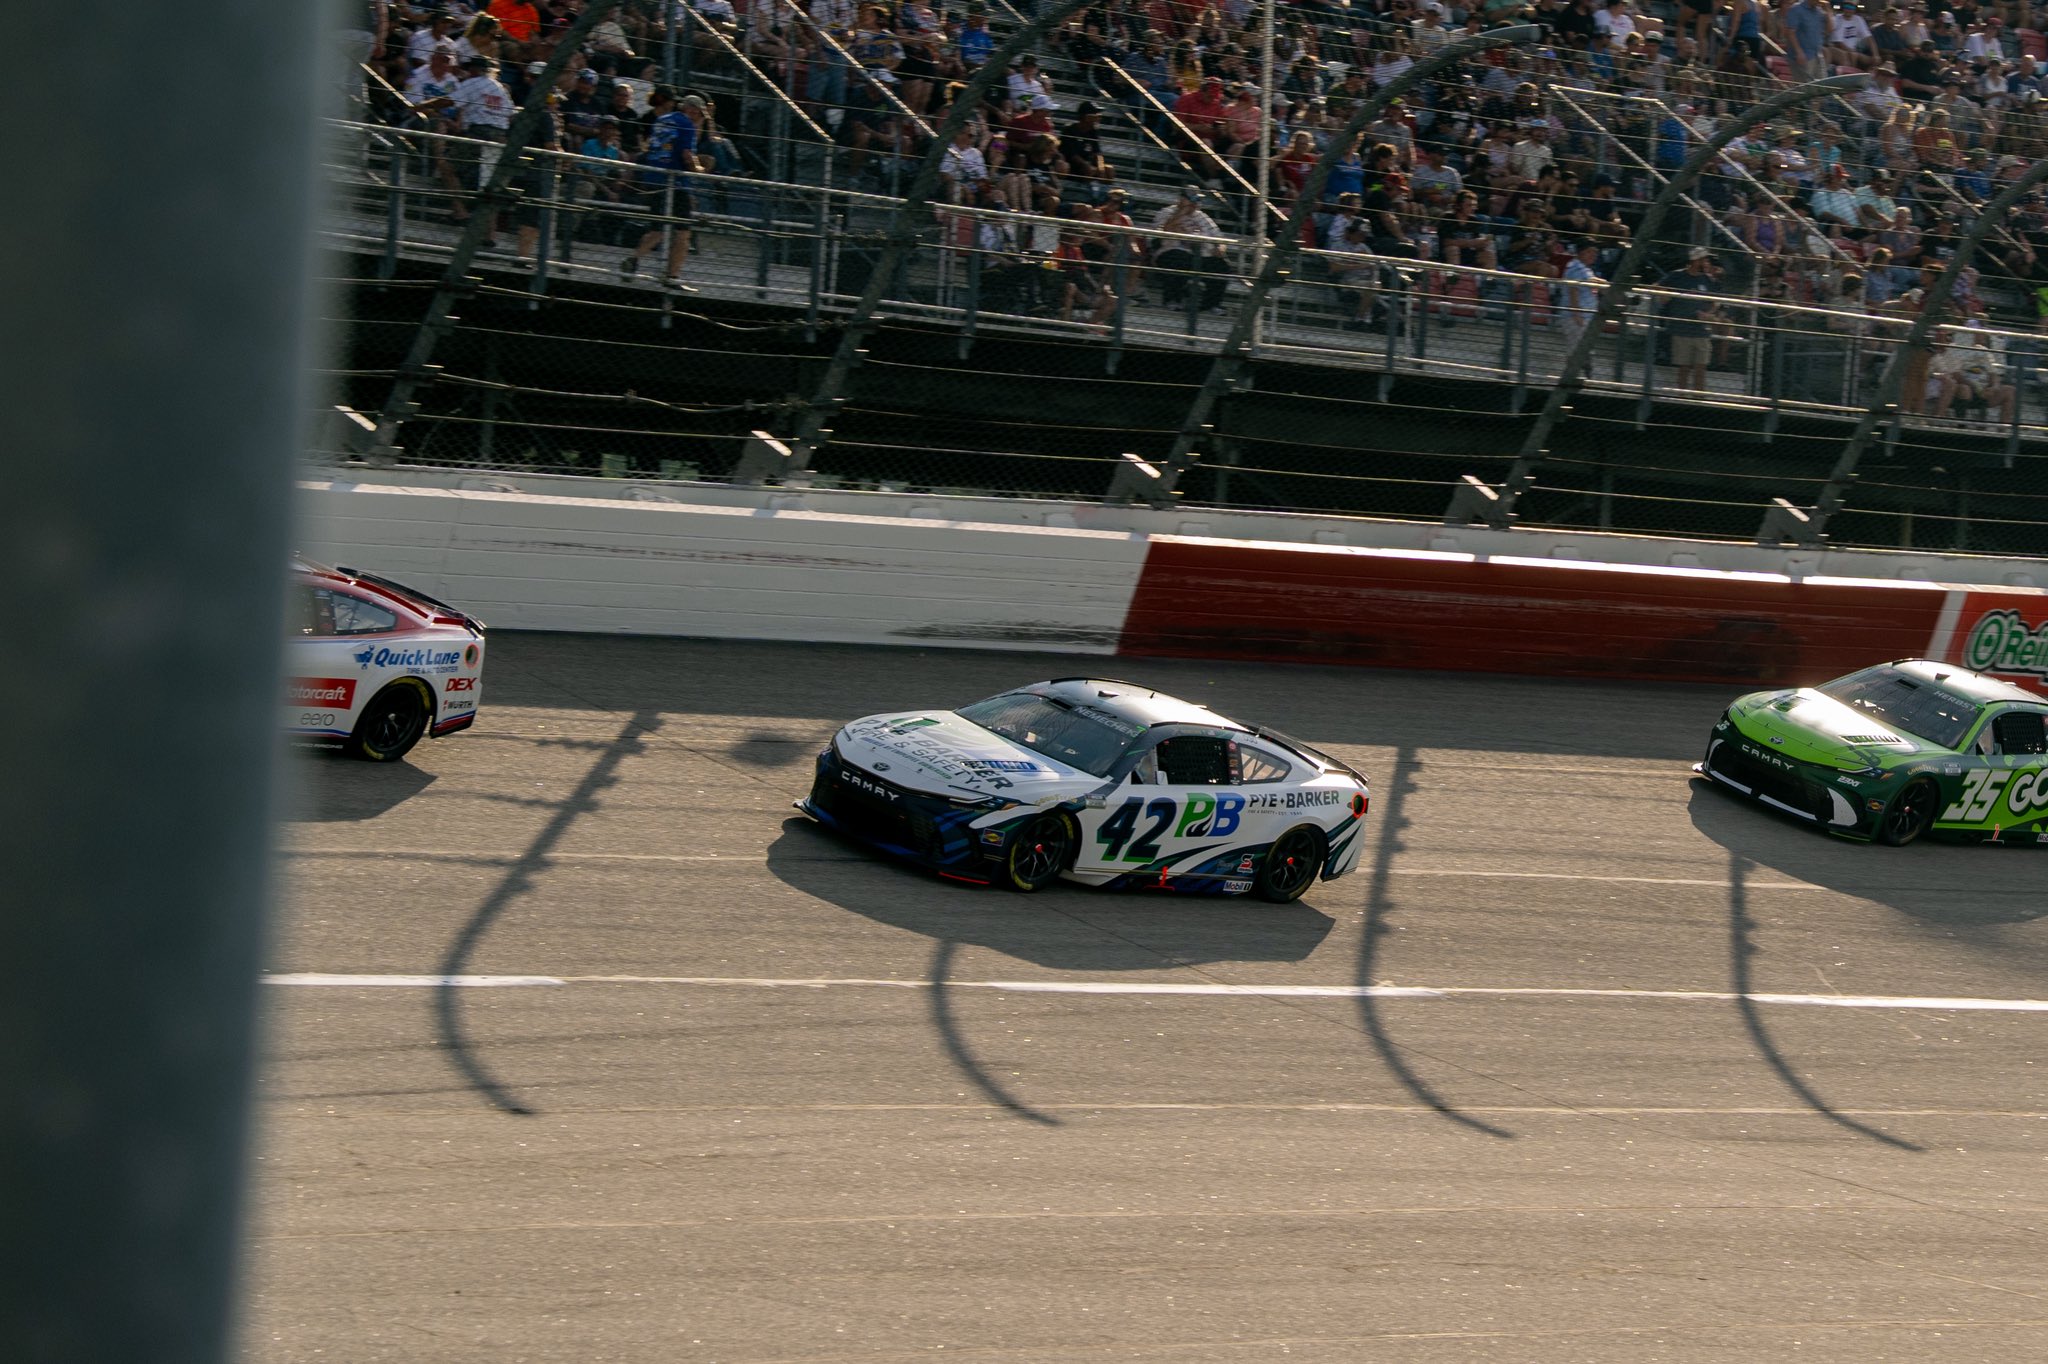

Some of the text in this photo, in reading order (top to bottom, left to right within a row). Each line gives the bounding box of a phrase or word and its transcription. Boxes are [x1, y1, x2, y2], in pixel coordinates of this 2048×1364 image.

[374, 648, 460, 667] Quick Lane
[287, 686, 346, 700] otorcraft
[445, 678, 477, 691] DEX
[1934, 690, 1976, 712] HERBST
[301, 713, 335, 726] eero
[1074, 706, 1140, 738] NEMECHEK
[912, 750, 981, 785] SAFETY
[1741, 744, 1794, 770] CAMRY
[841, 771, 899, 801] CAMRY
[1940, 768, 2014, 821] 35
[1249, 790, 1340, 808] PYE BARKER
[1097, 796, 1177, 863] 42
[1225, 881, 1243, 890] Mobil
